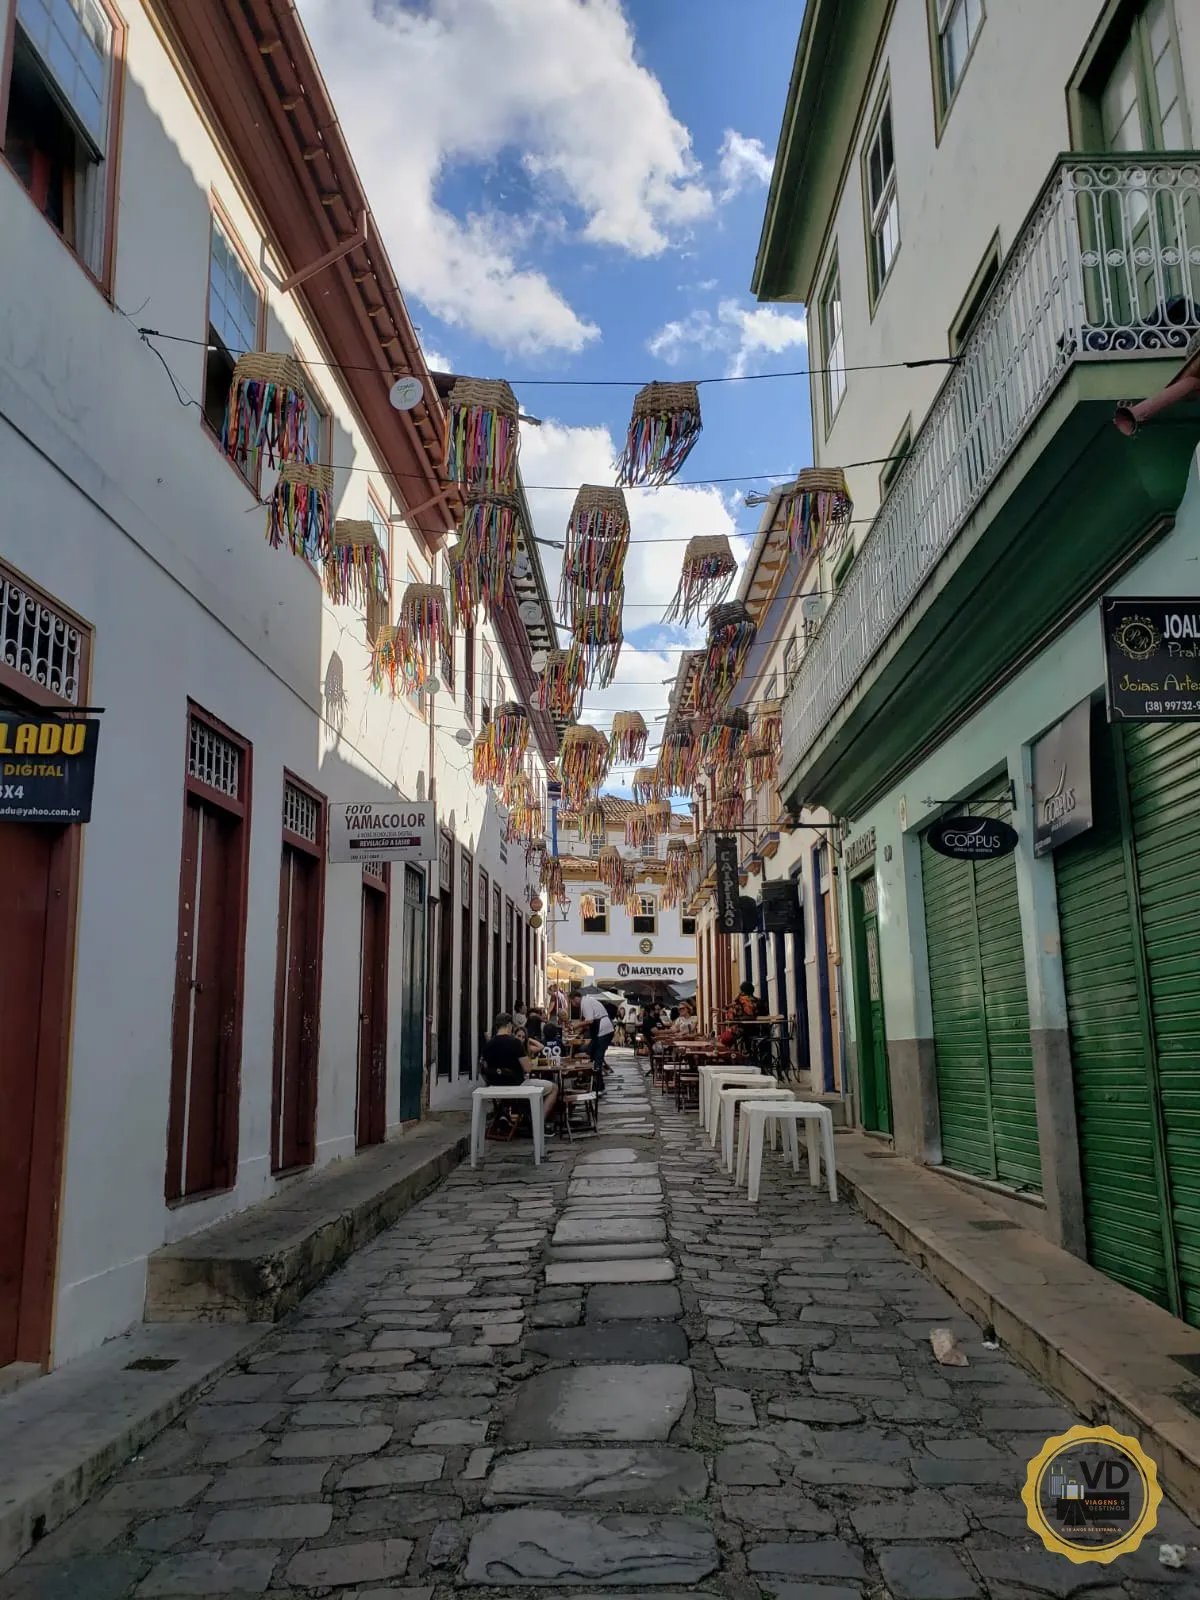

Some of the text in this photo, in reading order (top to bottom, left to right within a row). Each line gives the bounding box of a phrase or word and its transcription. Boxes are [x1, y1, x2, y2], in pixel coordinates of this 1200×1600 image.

[1164, 614, 1200, 638] JOAL
[1119, 673, 1159, 693] Joias
[1145, 701, 1163, 713] (38)
[4, 764, 64, 777] DIGITAL
[345, 805, 372, 815] FOTO
[345, 813, 426, 830] YAMACOLOR
